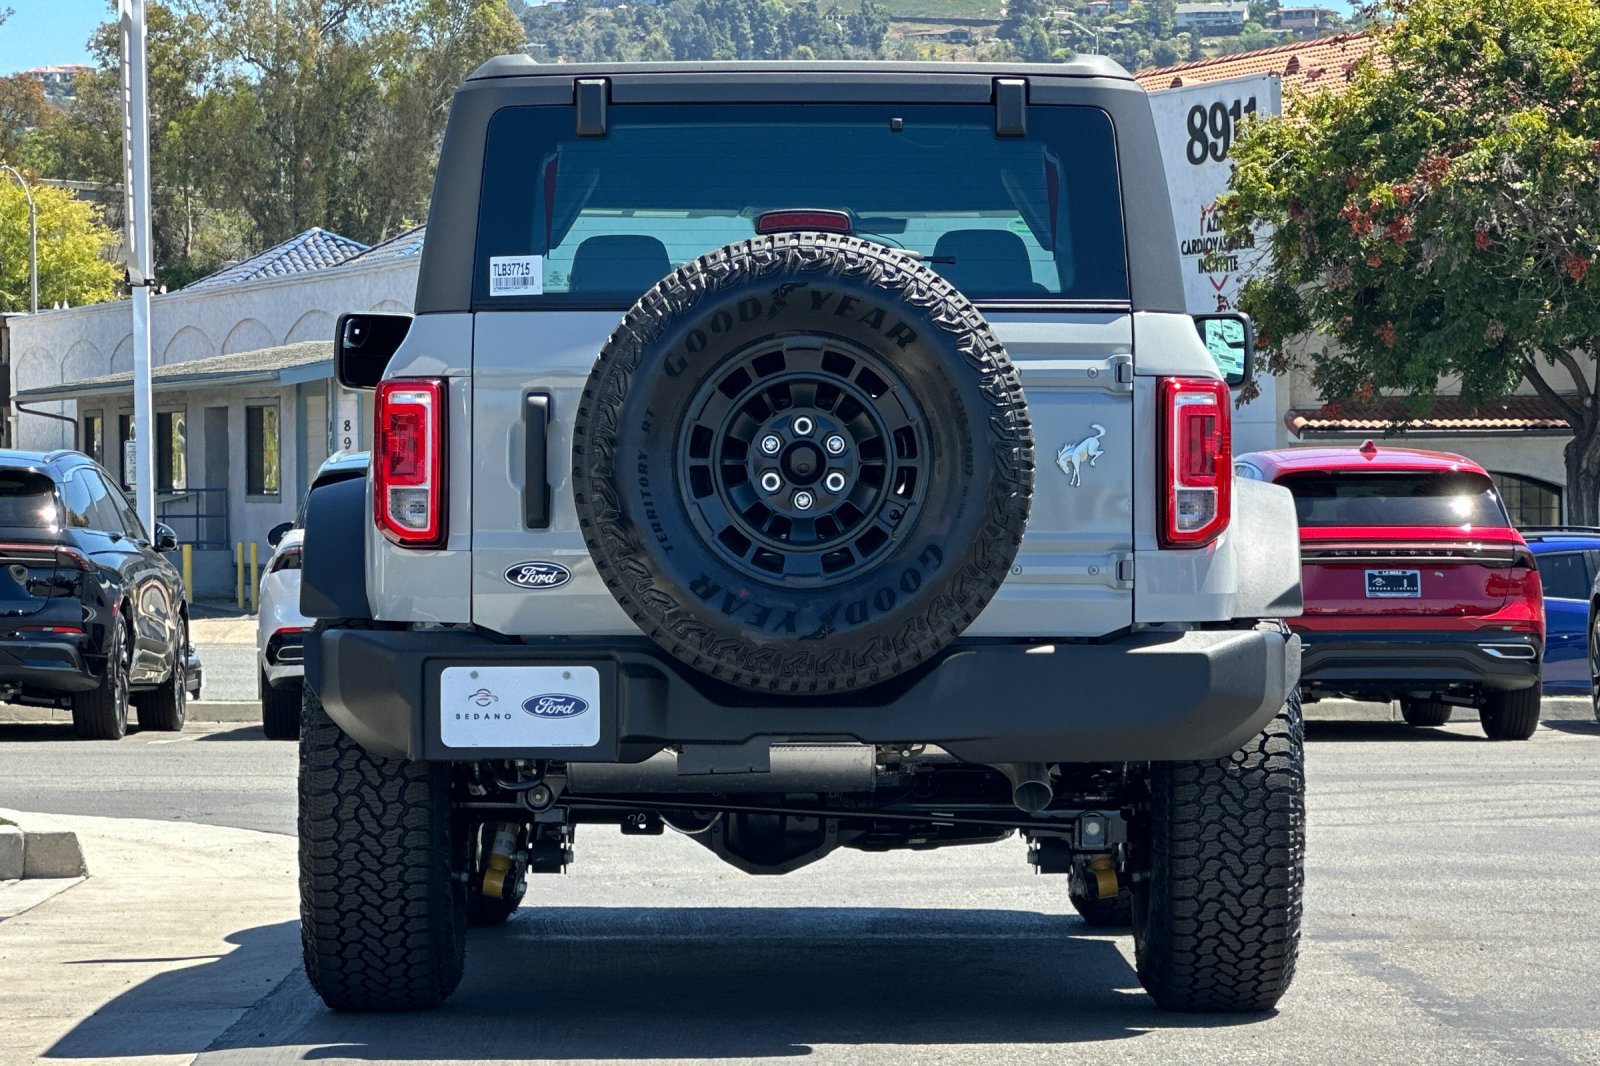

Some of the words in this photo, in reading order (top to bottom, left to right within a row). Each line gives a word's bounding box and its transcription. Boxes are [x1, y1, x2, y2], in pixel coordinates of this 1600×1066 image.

[493, 263, 530, 276] TLB37715
[641, 406, 655, 434] RT
[637, 450, 675, 554] TERRITORY
[517, 566, 558, 583] Ford
[534, 697, 575, 714] Ford
